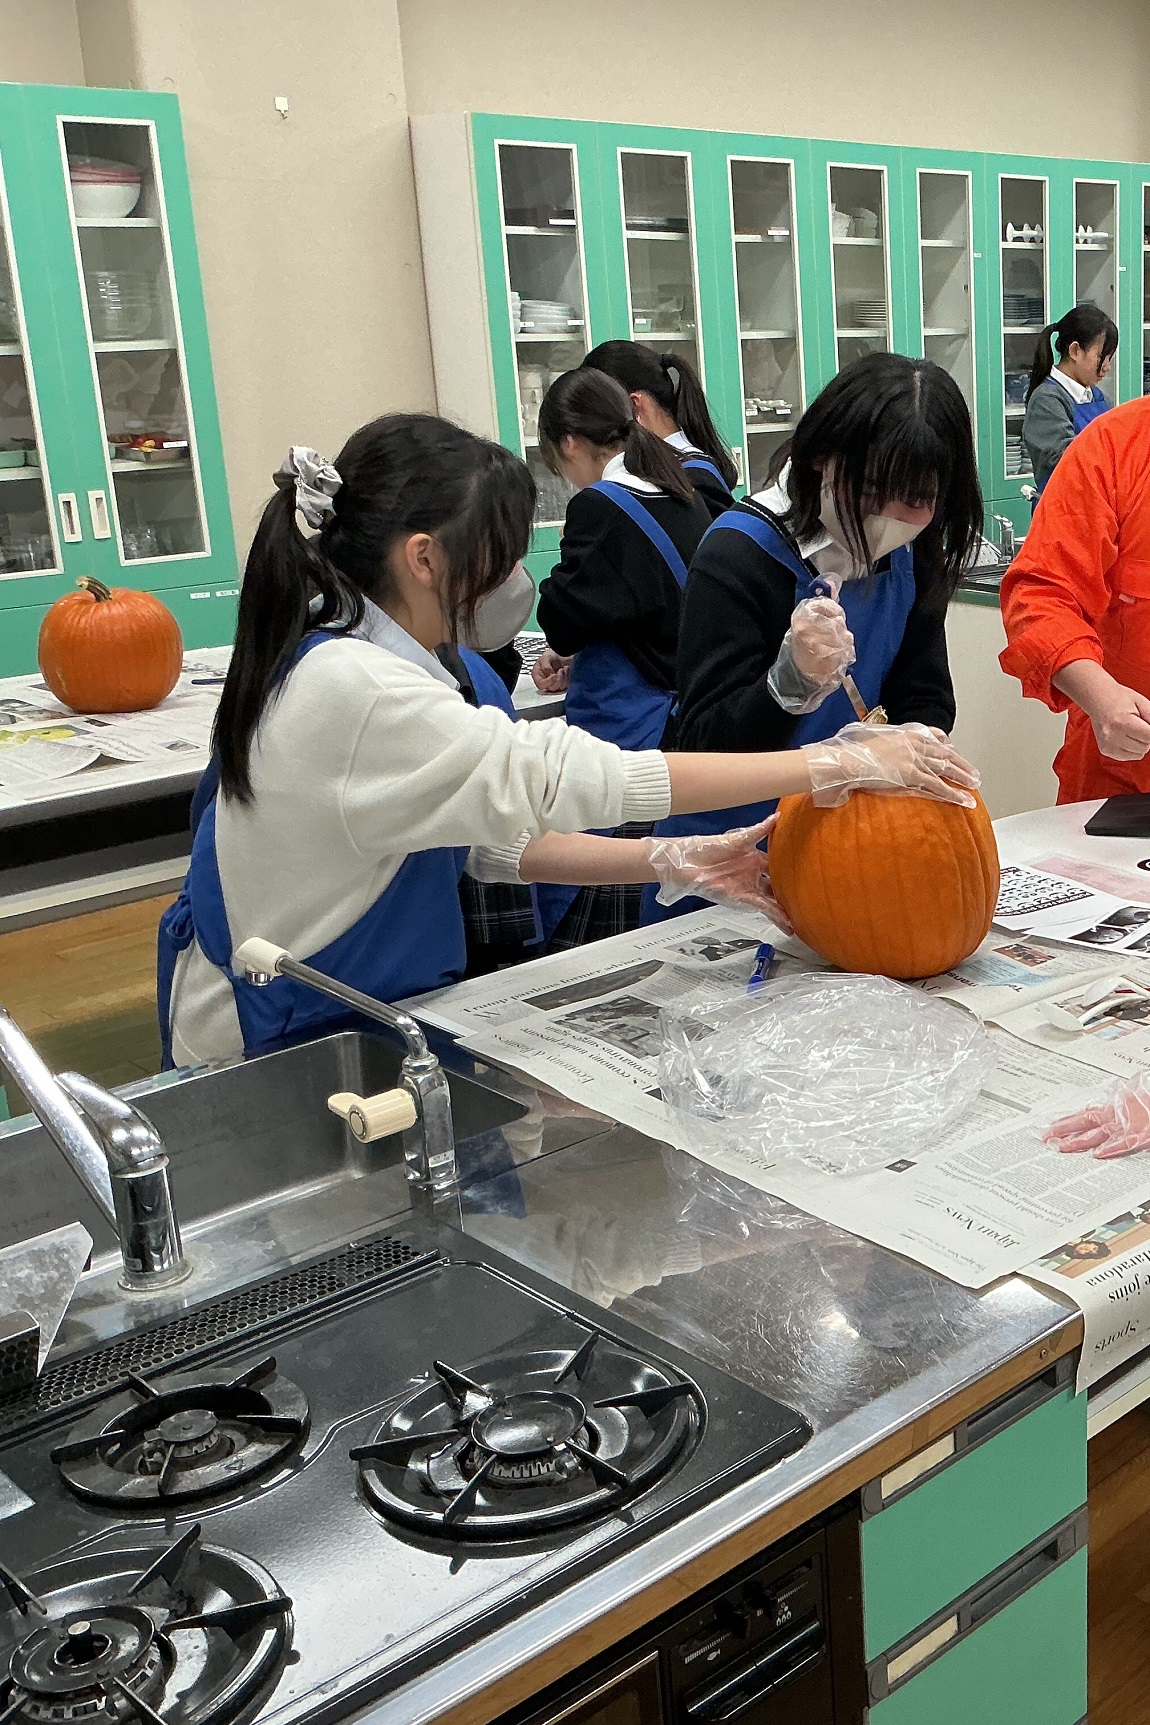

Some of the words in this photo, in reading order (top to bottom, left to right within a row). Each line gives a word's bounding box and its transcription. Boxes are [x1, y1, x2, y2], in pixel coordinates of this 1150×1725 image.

[634, 922, 716, 950] International
[460, 999, 511, 1014] Trump
[511, 980, 560, 1000] pardons
[560, 969, 601, 984] former
[494, 1034, 534, 1054] Business
[546, 1055, 596, 1084] Economy
[589, 1054, 631, 1079] economy
[602, 1047, 658, 1079] coronavirus
[943, 1206, 979, 1231] News
[977, 1224, 1020, 1249] Japan
[1108, 1275, 1142, 1304] joins
[1094, 1320, 1141, 1354] Sports
